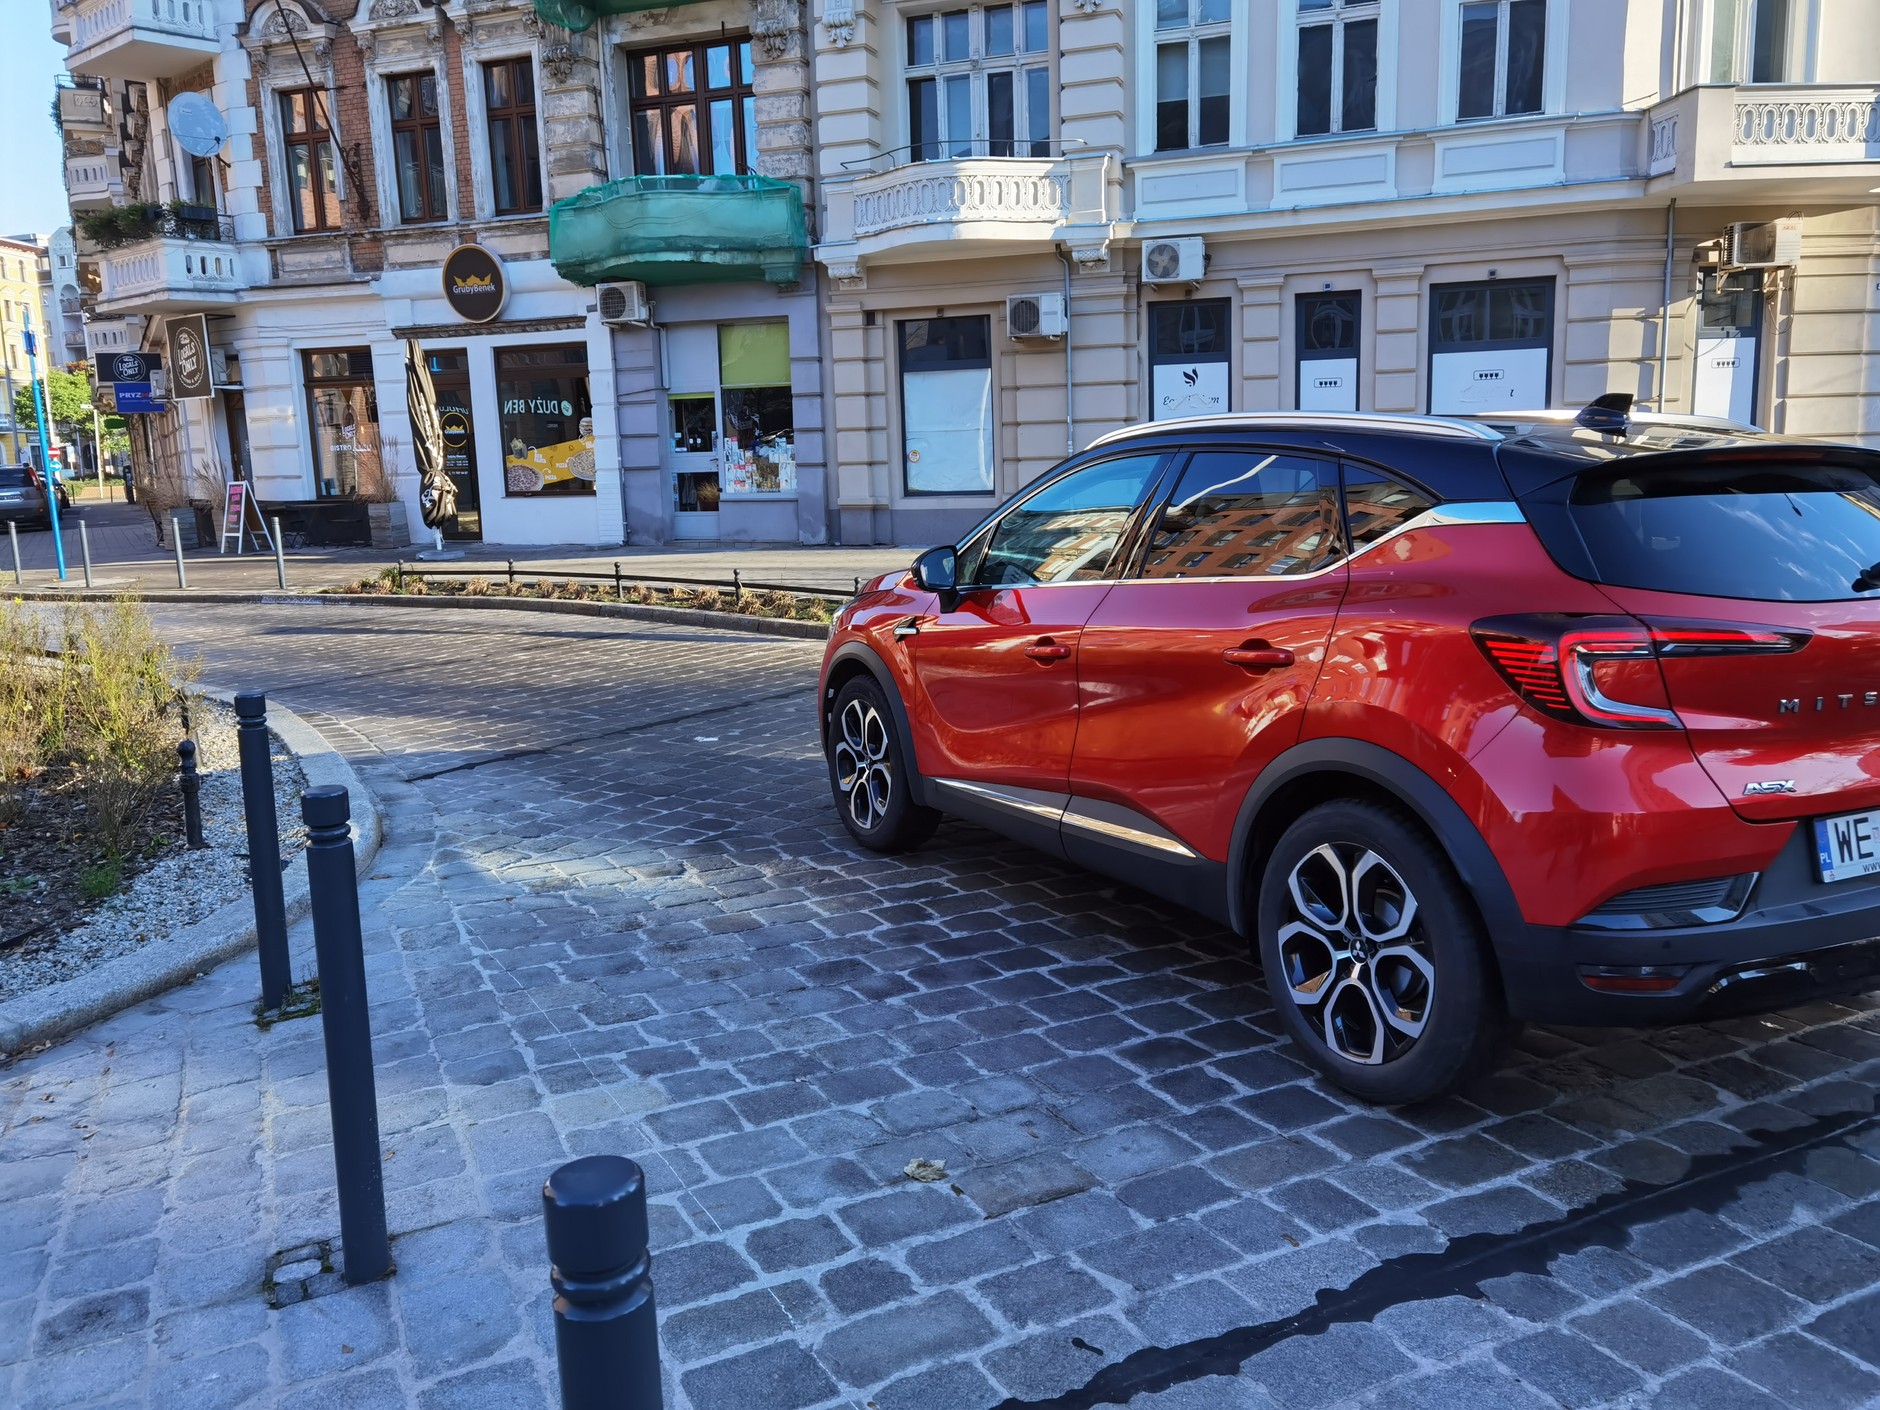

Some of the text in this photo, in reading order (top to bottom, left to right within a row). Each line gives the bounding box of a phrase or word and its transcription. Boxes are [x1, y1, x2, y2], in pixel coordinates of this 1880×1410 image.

[452, 283, 496, 295] GrubyBenek
[178, 341, 196, 365] LOCALS
[118, 360, 139, 371] LOCALS
[122, 367, 139, 377] ONLY
[181, 355, 197, 376] ONLY
[1743, 779, 1797, 795] ASX
[1834, 816, 1875, 863] WE
[1820, 852, 1832, 864] PL
